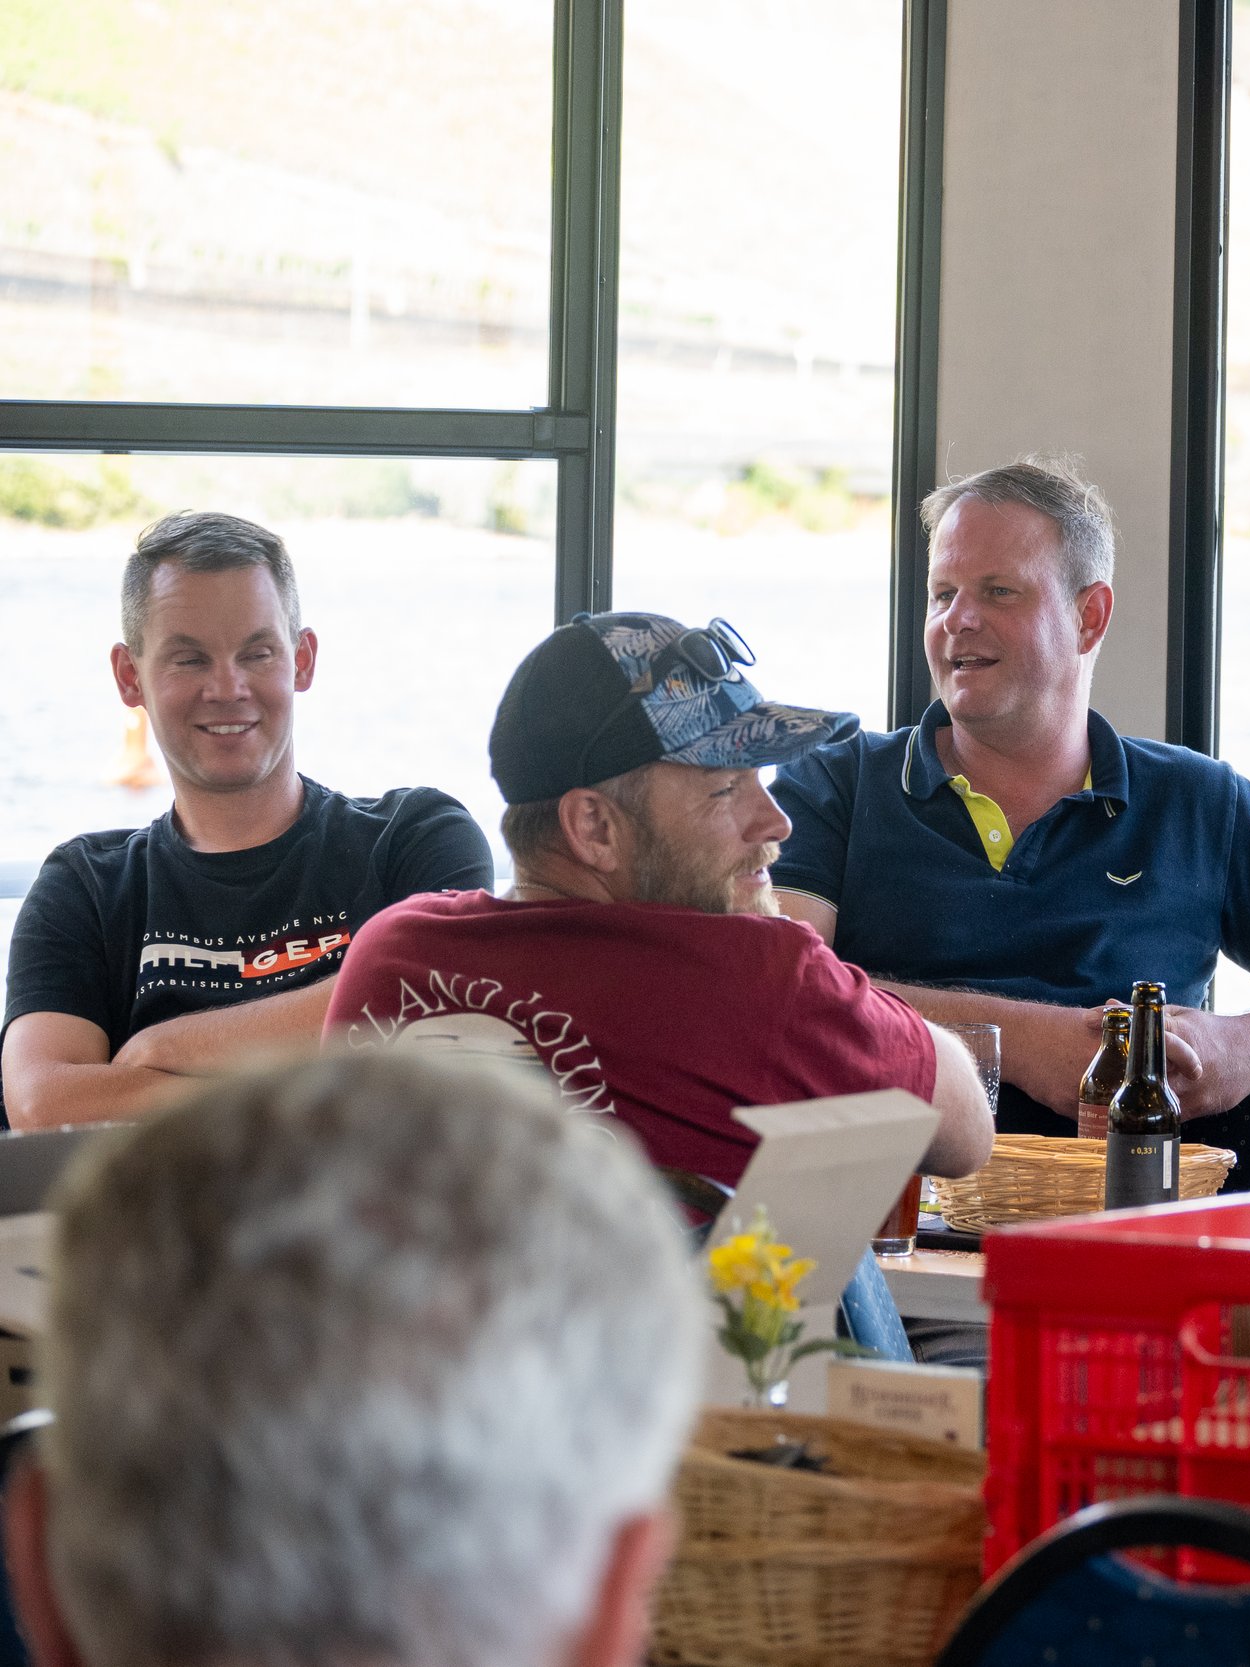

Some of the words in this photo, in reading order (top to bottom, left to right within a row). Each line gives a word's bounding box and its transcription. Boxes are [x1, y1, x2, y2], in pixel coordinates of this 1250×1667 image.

[143, 930, 224, 946] OLUMBUS
[236, 919, 301, 945] AVENUE
[313, 911, 347, 925] NYC
[1136, 1147, 1152, 1155] 0,33
